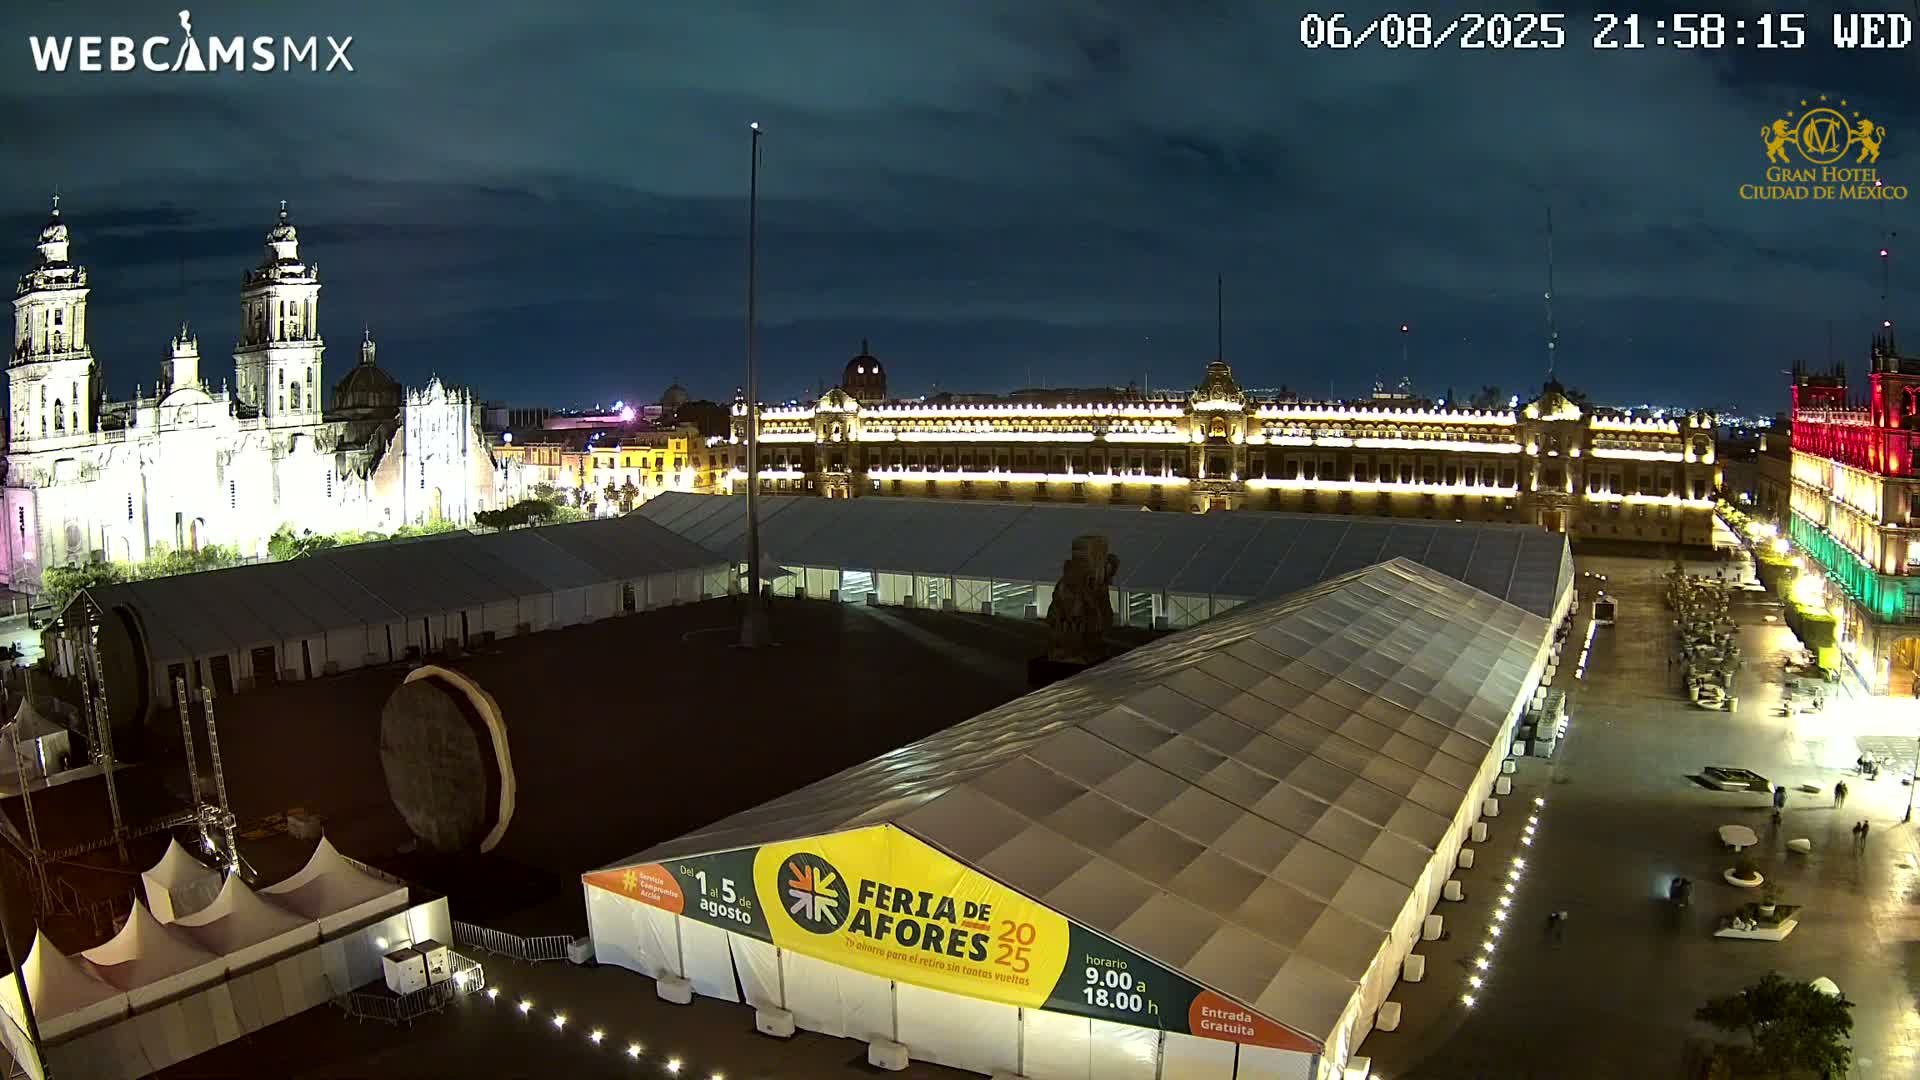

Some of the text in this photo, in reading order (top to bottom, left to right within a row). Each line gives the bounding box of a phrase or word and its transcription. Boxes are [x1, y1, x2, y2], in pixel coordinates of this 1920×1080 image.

[680, 864, 752, 909] Del 1 al 5 de
[700, 898, 752, 925] agosto
[857, 878, 992, 925] FERIA DE
[847, 907, 990, 963] AFORES
[998, 919, 1036, 946] 20
[856, 941, 885, 957] ahorro
[886, 949, 907, 961] para
[909, 953, 918, 963] el
[919, 956, 945, 969] retiro
[947, 962, 960, 973] sin
[962, 966, 992, 980] tantas
[994, 971, 1030, 987] vueltas
[994, 943, 1032, 974] 25
[1086, 953, 1128, 970] horario
[1085, 967, 1147, 993] 9.00 a
[1083, 986, 1159, 1015] 18.00 h
[1201, 1005, 1252, 1024] Entrada
[1200, 1019, 1255, 1037] Gratuita
